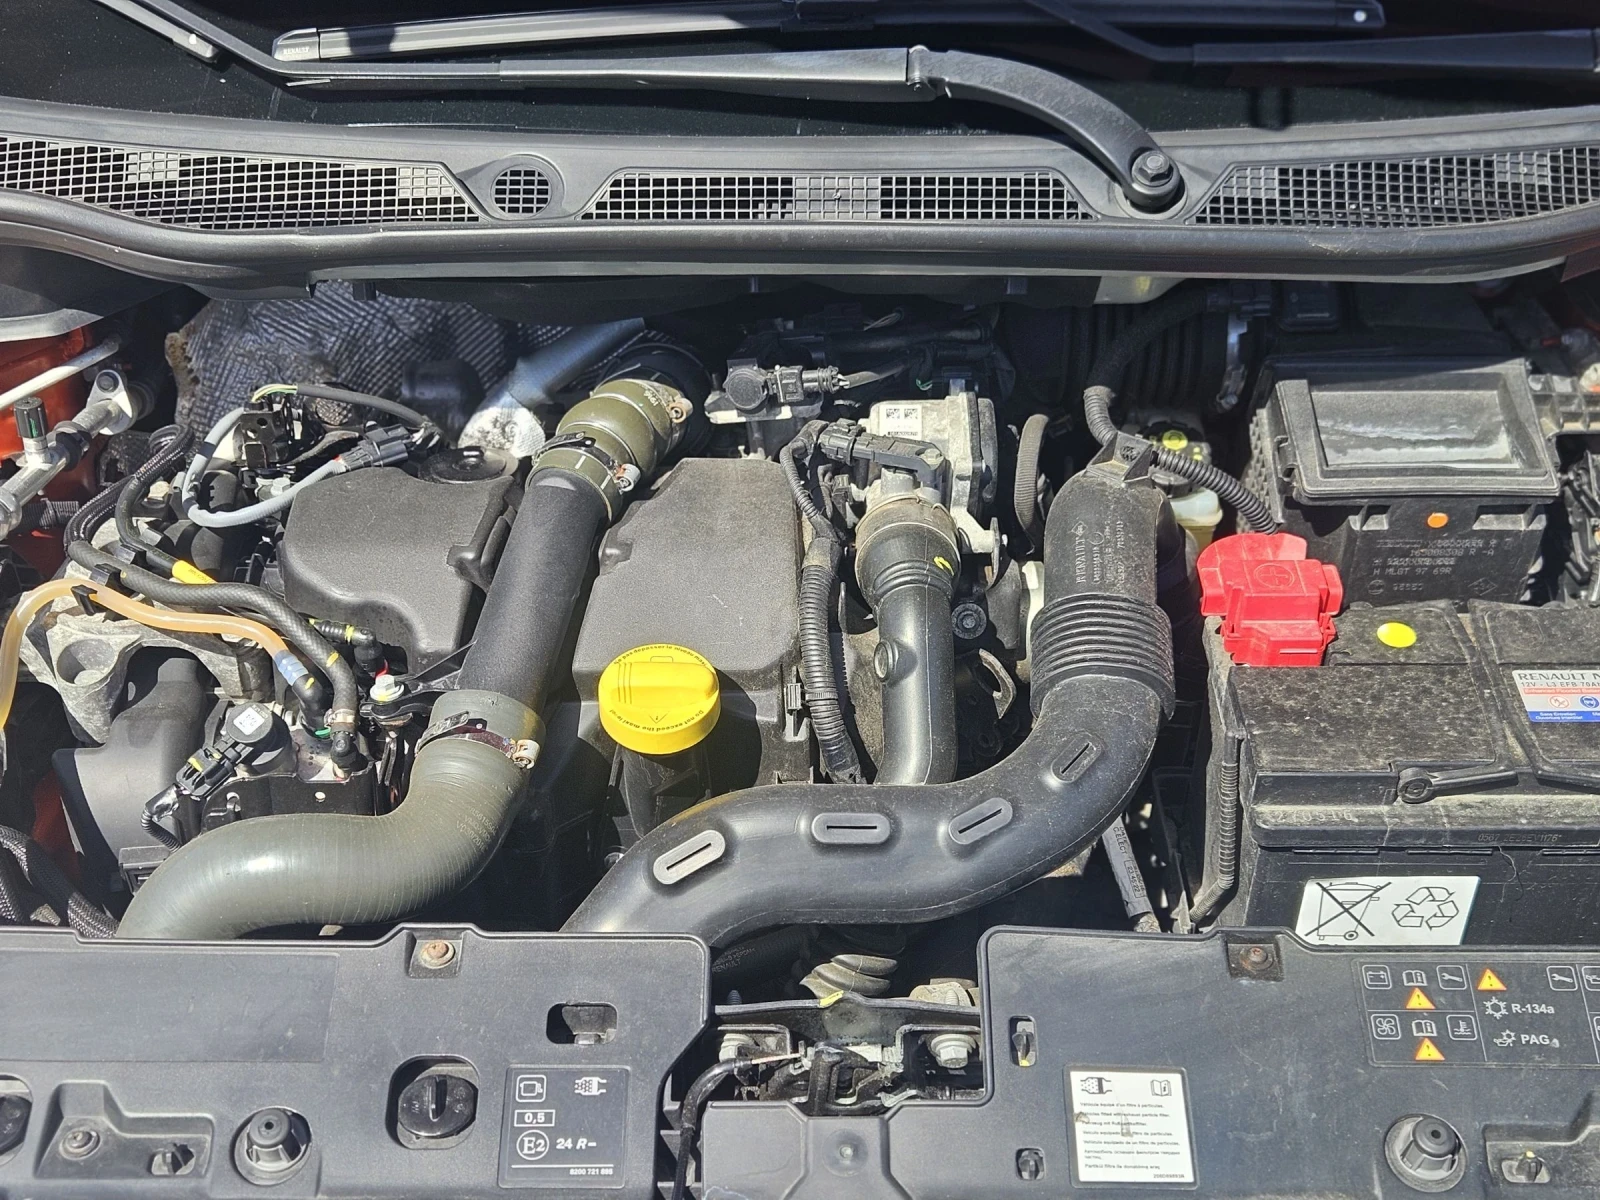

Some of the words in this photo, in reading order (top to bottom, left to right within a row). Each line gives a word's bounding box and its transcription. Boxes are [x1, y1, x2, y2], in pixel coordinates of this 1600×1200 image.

[1075, 536, 1086, 583] RENAULT
[1517, 673, 1588, 681] RENAULT
[1510, 1003, 1555, 1014] R-134a
[1519, 1034, 1551, 1045] PAG
[524, 1112, 546, 1125] 0,5
[521, 1136, 546, 1155] E2
[555, 1138, 574, 1150] 24
